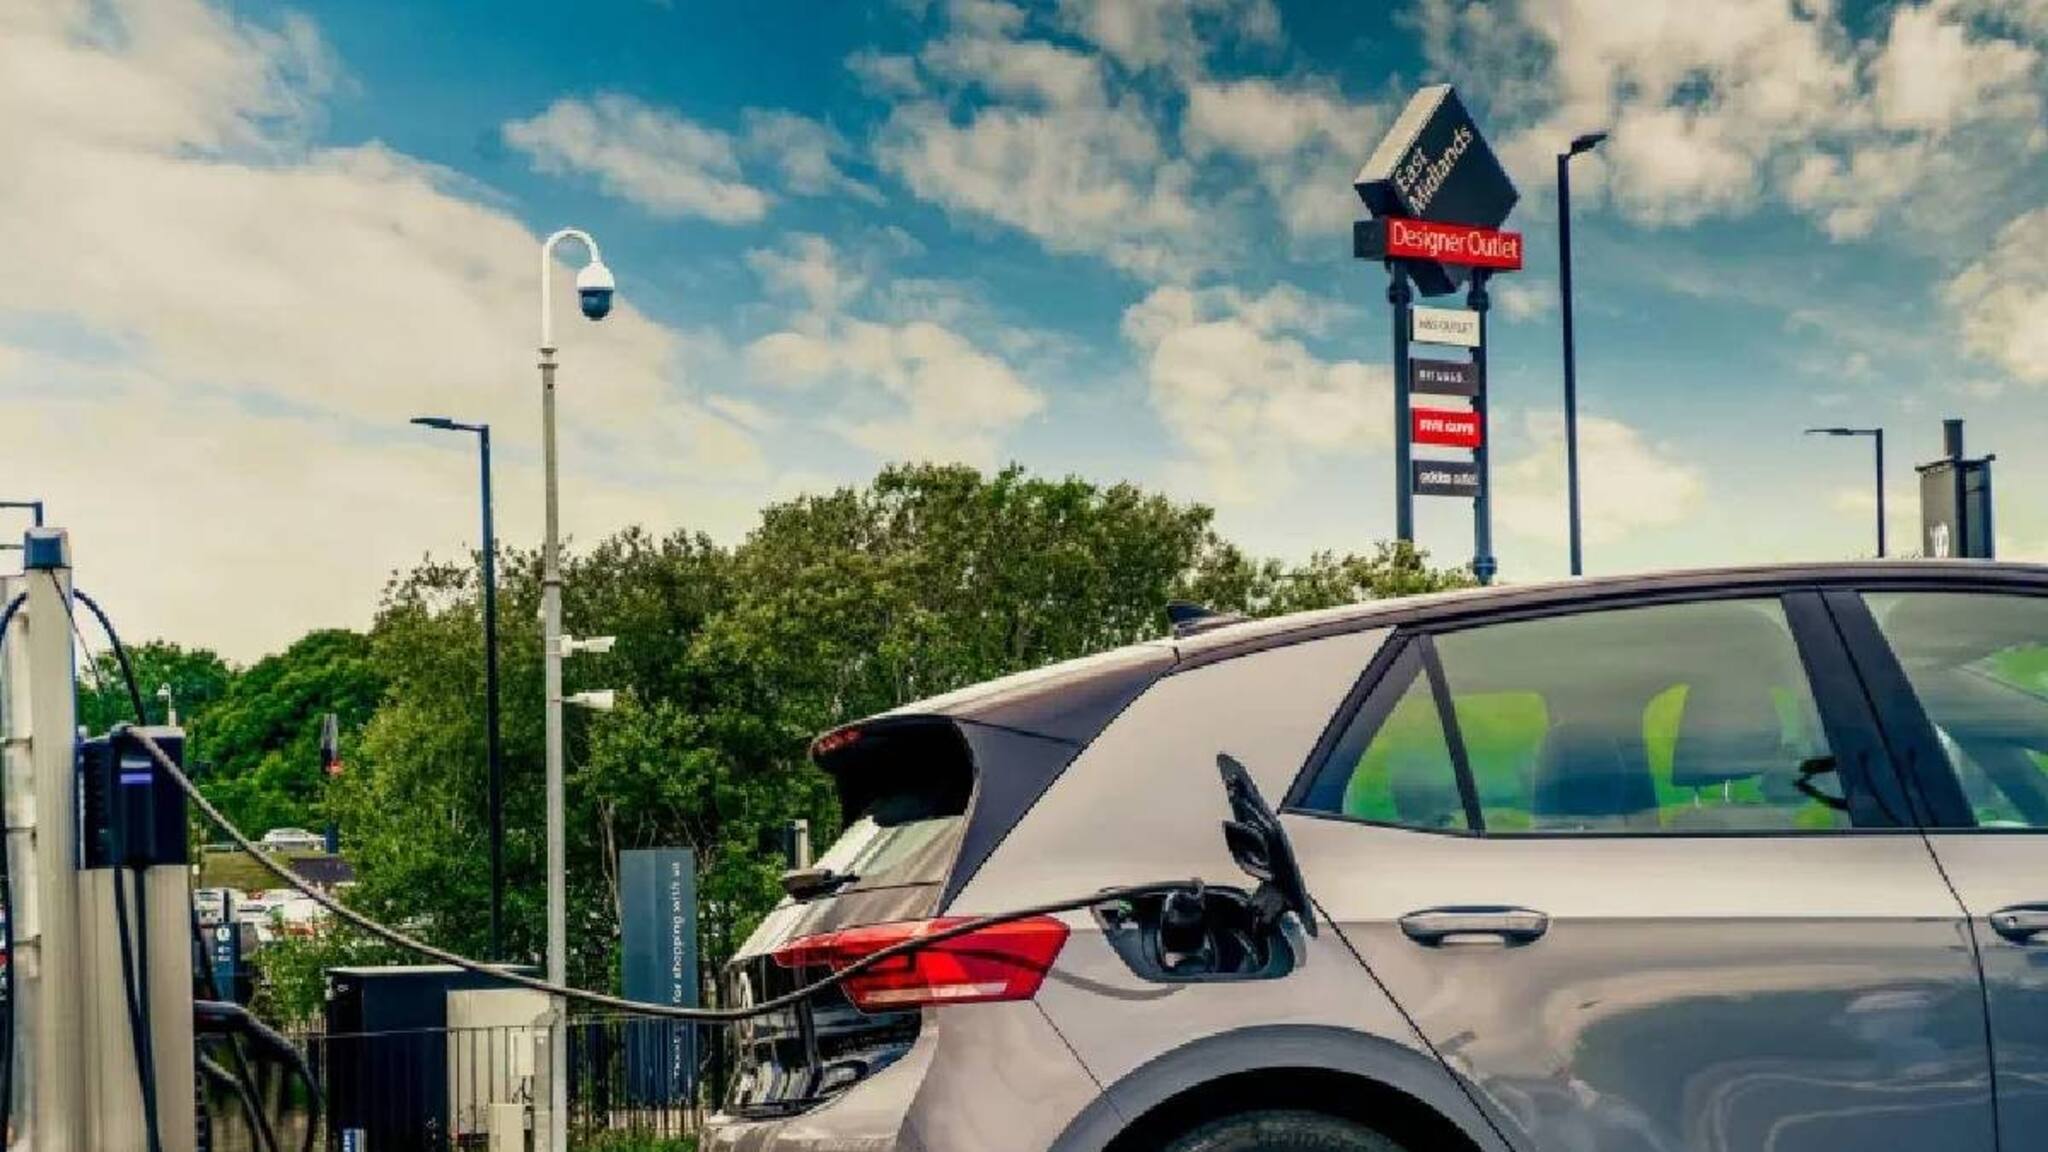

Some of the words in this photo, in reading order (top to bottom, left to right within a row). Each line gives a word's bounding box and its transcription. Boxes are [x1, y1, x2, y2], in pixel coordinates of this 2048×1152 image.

[1395, 147, 1427, 192] East
[1409, 126, 1473, 216] Midlands
[1393, 221, 1465, 257] Designer
[1467, 231, 1519, 259] Outlet
[1419, 419, 1443, 432] FIVE
[1445, 422, 1474, 436] GUYS
[672, 882, 682, 912] with
[672, 917, 685, 981] shopping
[671, 983, 682, 1004] for
